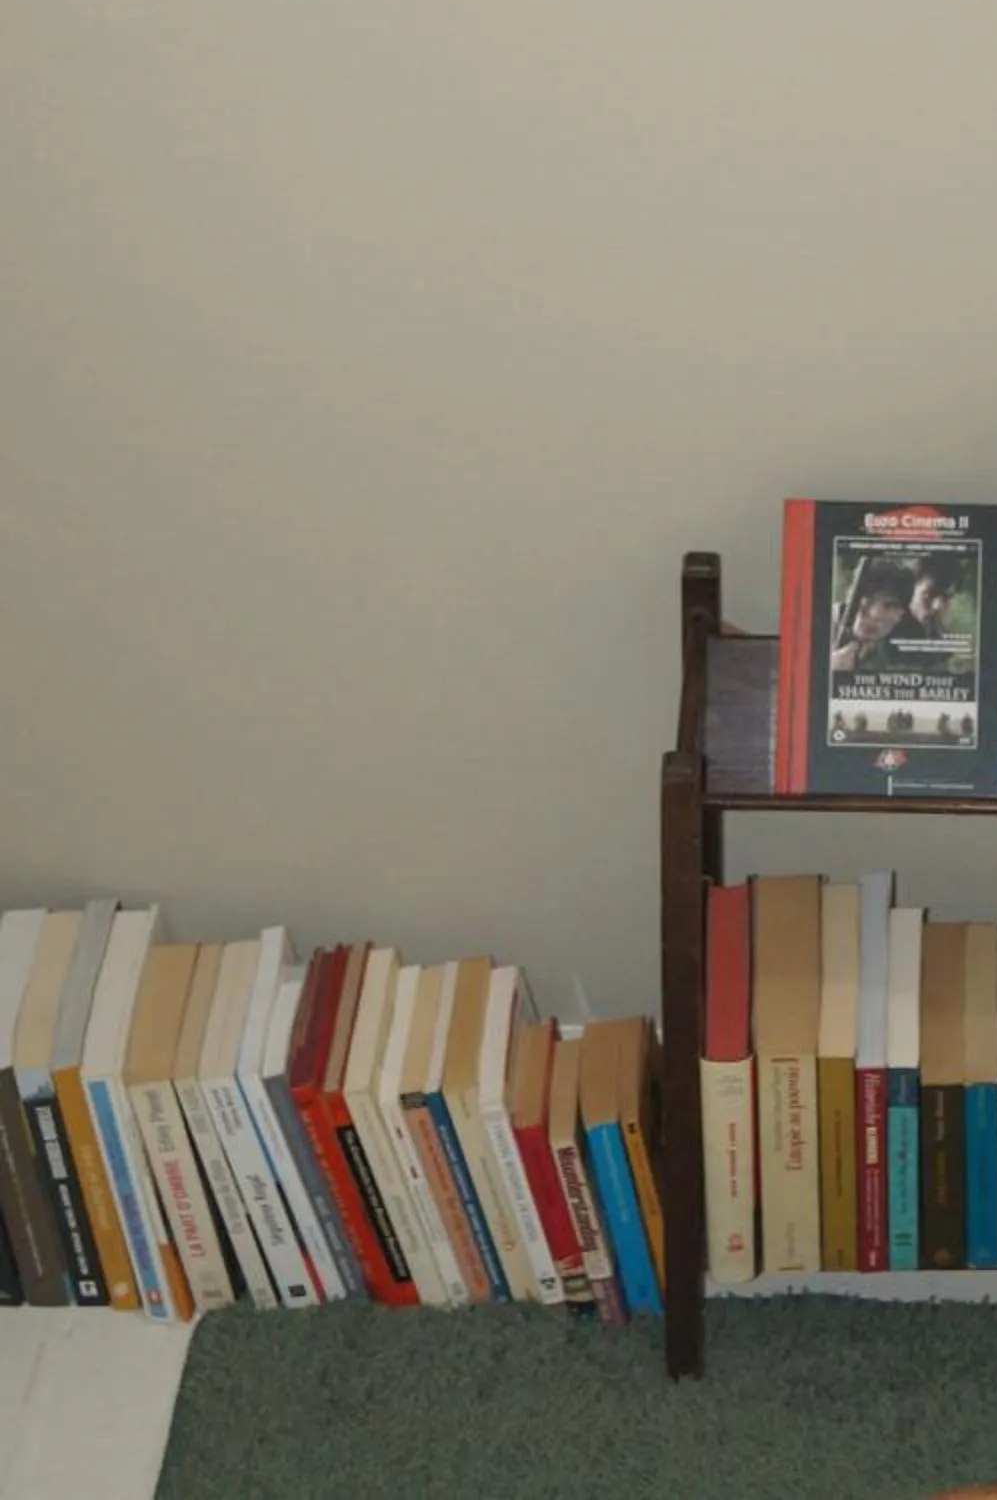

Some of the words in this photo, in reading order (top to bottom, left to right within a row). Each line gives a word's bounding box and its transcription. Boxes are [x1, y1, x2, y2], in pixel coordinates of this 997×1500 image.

[901, 514, 955, 529] Cinema
[880, 672, 923, 687] WIND
[838, 685, 891, 700] SHAKES
[919, 687, 970, 701] BARLEY
[164, 1157, 191, 1211] D'OMBRE
[181, 1211, 202, 1242] PART
[188, 1242, 207, 1259] LA
